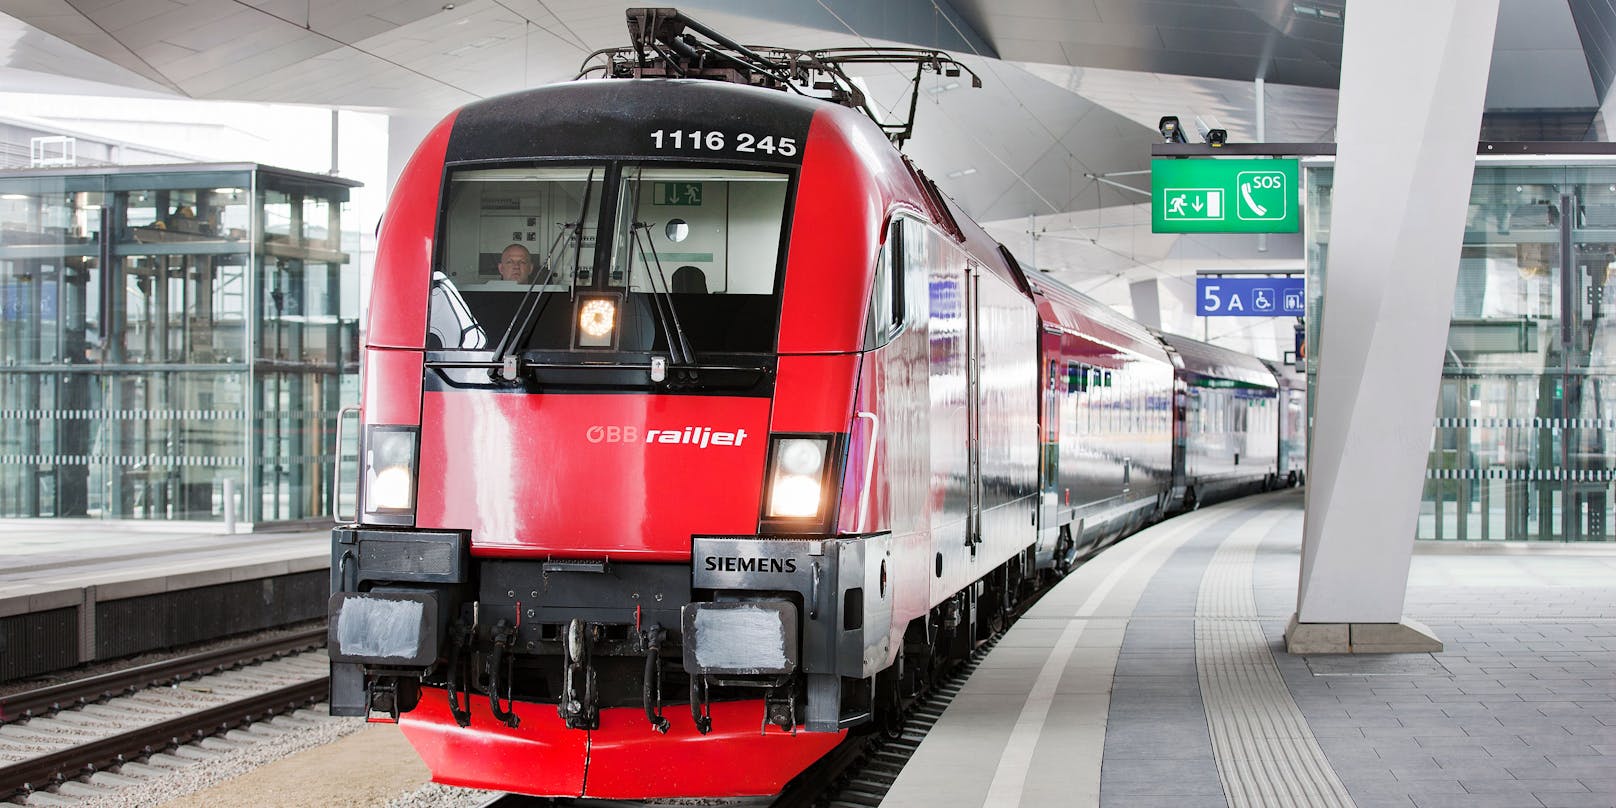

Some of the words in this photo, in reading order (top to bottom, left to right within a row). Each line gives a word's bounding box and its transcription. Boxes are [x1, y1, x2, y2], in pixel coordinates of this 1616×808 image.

[650, 129, 725, 151] 1116
[736, 132, 797, 157] 245
[1253, 176, 1281, 189] SOS
[1204, 286, 1221, 312] 5
[1227, 294, 1244, 311] A
[645, 426, 748, 449] railjet
[705, 556, 797, 573] SIEMENS
